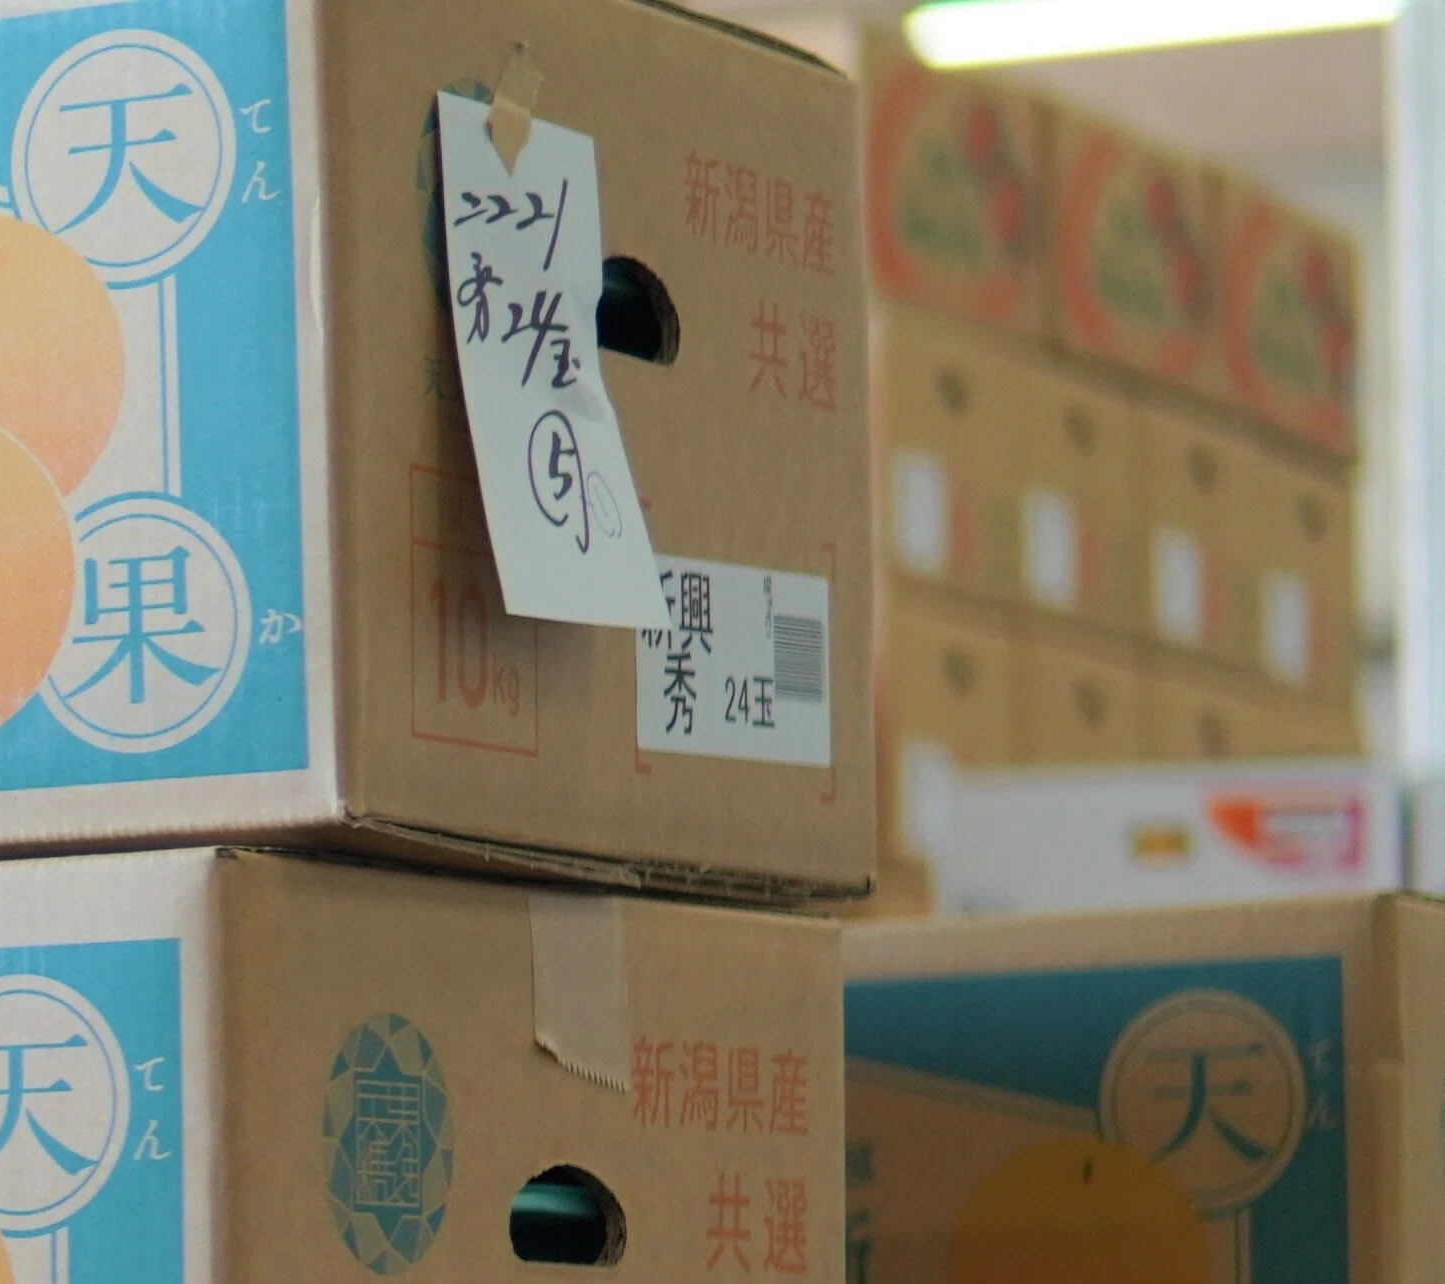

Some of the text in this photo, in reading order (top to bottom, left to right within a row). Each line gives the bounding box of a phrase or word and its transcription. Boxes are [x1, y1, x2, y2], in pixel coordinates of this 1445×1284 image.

[56, 83, 202, 236] 天
[240, 98, 280, 204] てん
[684, 152, 835, 276] 新潟県産
[750, 301, 836, 411] 共選
[67, 545, 220, 703] 果
[260, 609, 302, 644] か
[664, 652, 773, 734] 秀 24玉
[134, 1056, 172, 1162] てん
[632, 1036, 809, 1136] 新潟県産
[1146, 1040, 1274, 1165] 天
[706, 1174, 809, 1275] 共選
